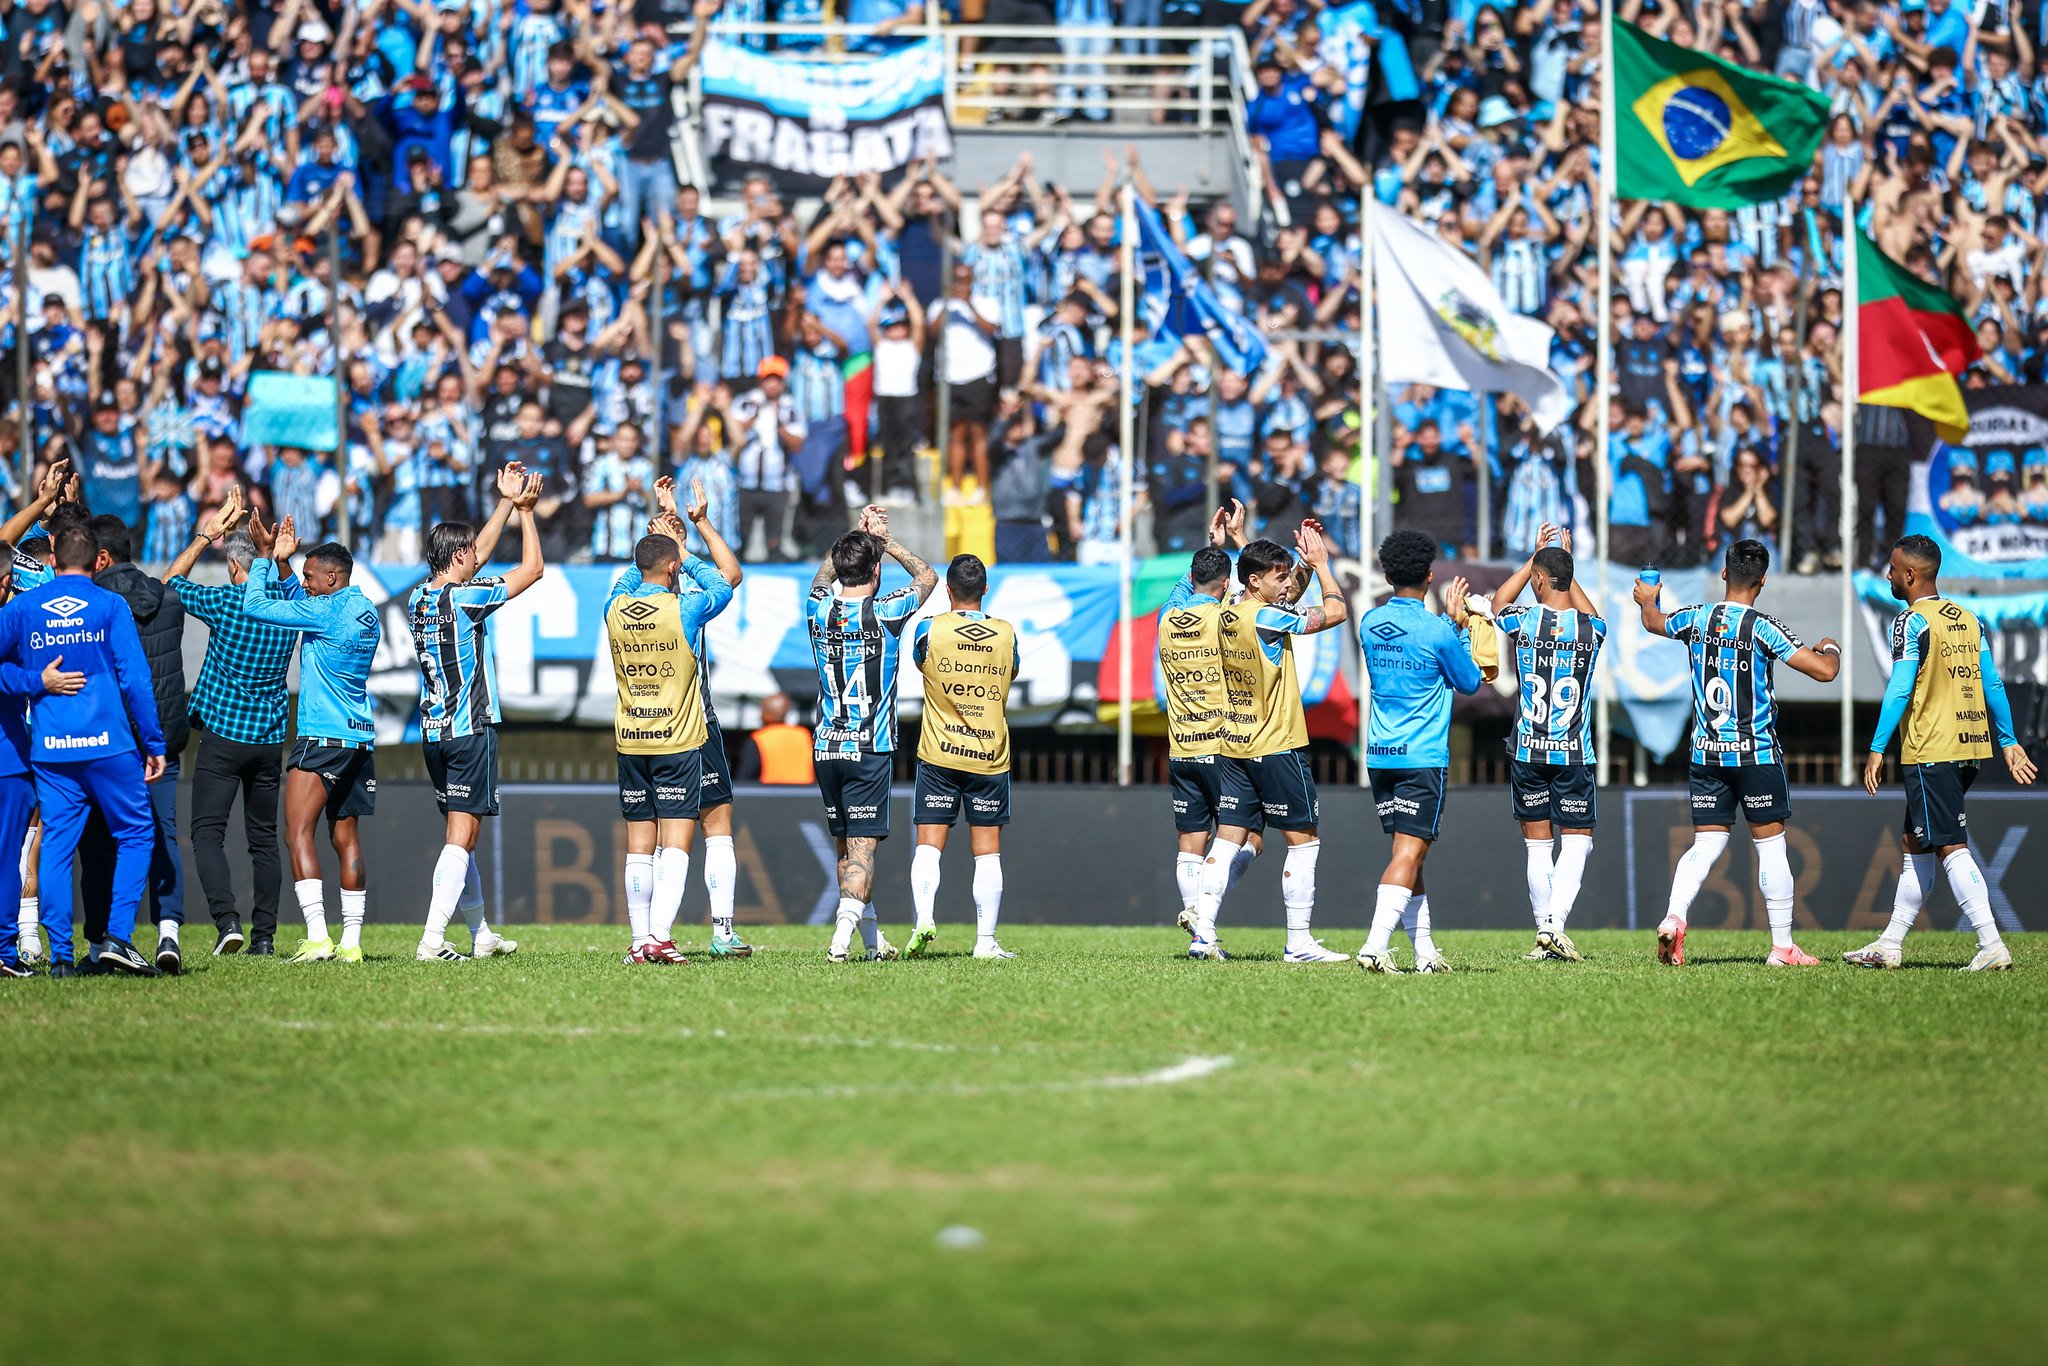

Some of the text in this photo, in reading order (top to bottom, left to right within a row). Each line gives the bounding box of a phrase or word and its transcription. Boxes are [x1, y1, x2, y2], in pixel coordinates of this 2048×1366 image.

[46, 617, 84, 628] umbro
[623, 622, 656, 631] umbro
[45, 628, 105, 646] banrisul
[825, 626, 885, 640] banrisul
[1171, 630, 1200, 639] umbro
[624, 638, 678, 652] banrisul
[818, 644, 876, 656] NATHAN
[957, 643, 993, 653] umbro
[1372, 643, 1403, 653] umbro
[1533, 636, 1596, 652] banrisul
[1172, 646, 1219, 660] banrisu
[1522, 653, 1585, 668] G. NUNES
[955, 661, 1007, 676] banrisul
[1372, 655, 1427, 671] banrisul
[1707, 656, 1749, 671] AREZO
[420, 652, 445, 704] 3
[823, 663, 873, 718] 14
[942, 683, 985, 697] vero
[1521, 673, 1581, 728] 39
[1705, 676, 1732, 729] 9
[422, 716, 452, 729] imed
[44, 731, 109, 750] Unimed
[621, 727, 672, 740] Unimed
[820, 728, 870, 741] Unimed
[1175, 726, 1223, 743] Unimed
[1521, 734, 1579, 751] Unimed
[1696, 736, 1751, 752] Unimed
[940, 741, 995, 761] Unimed
